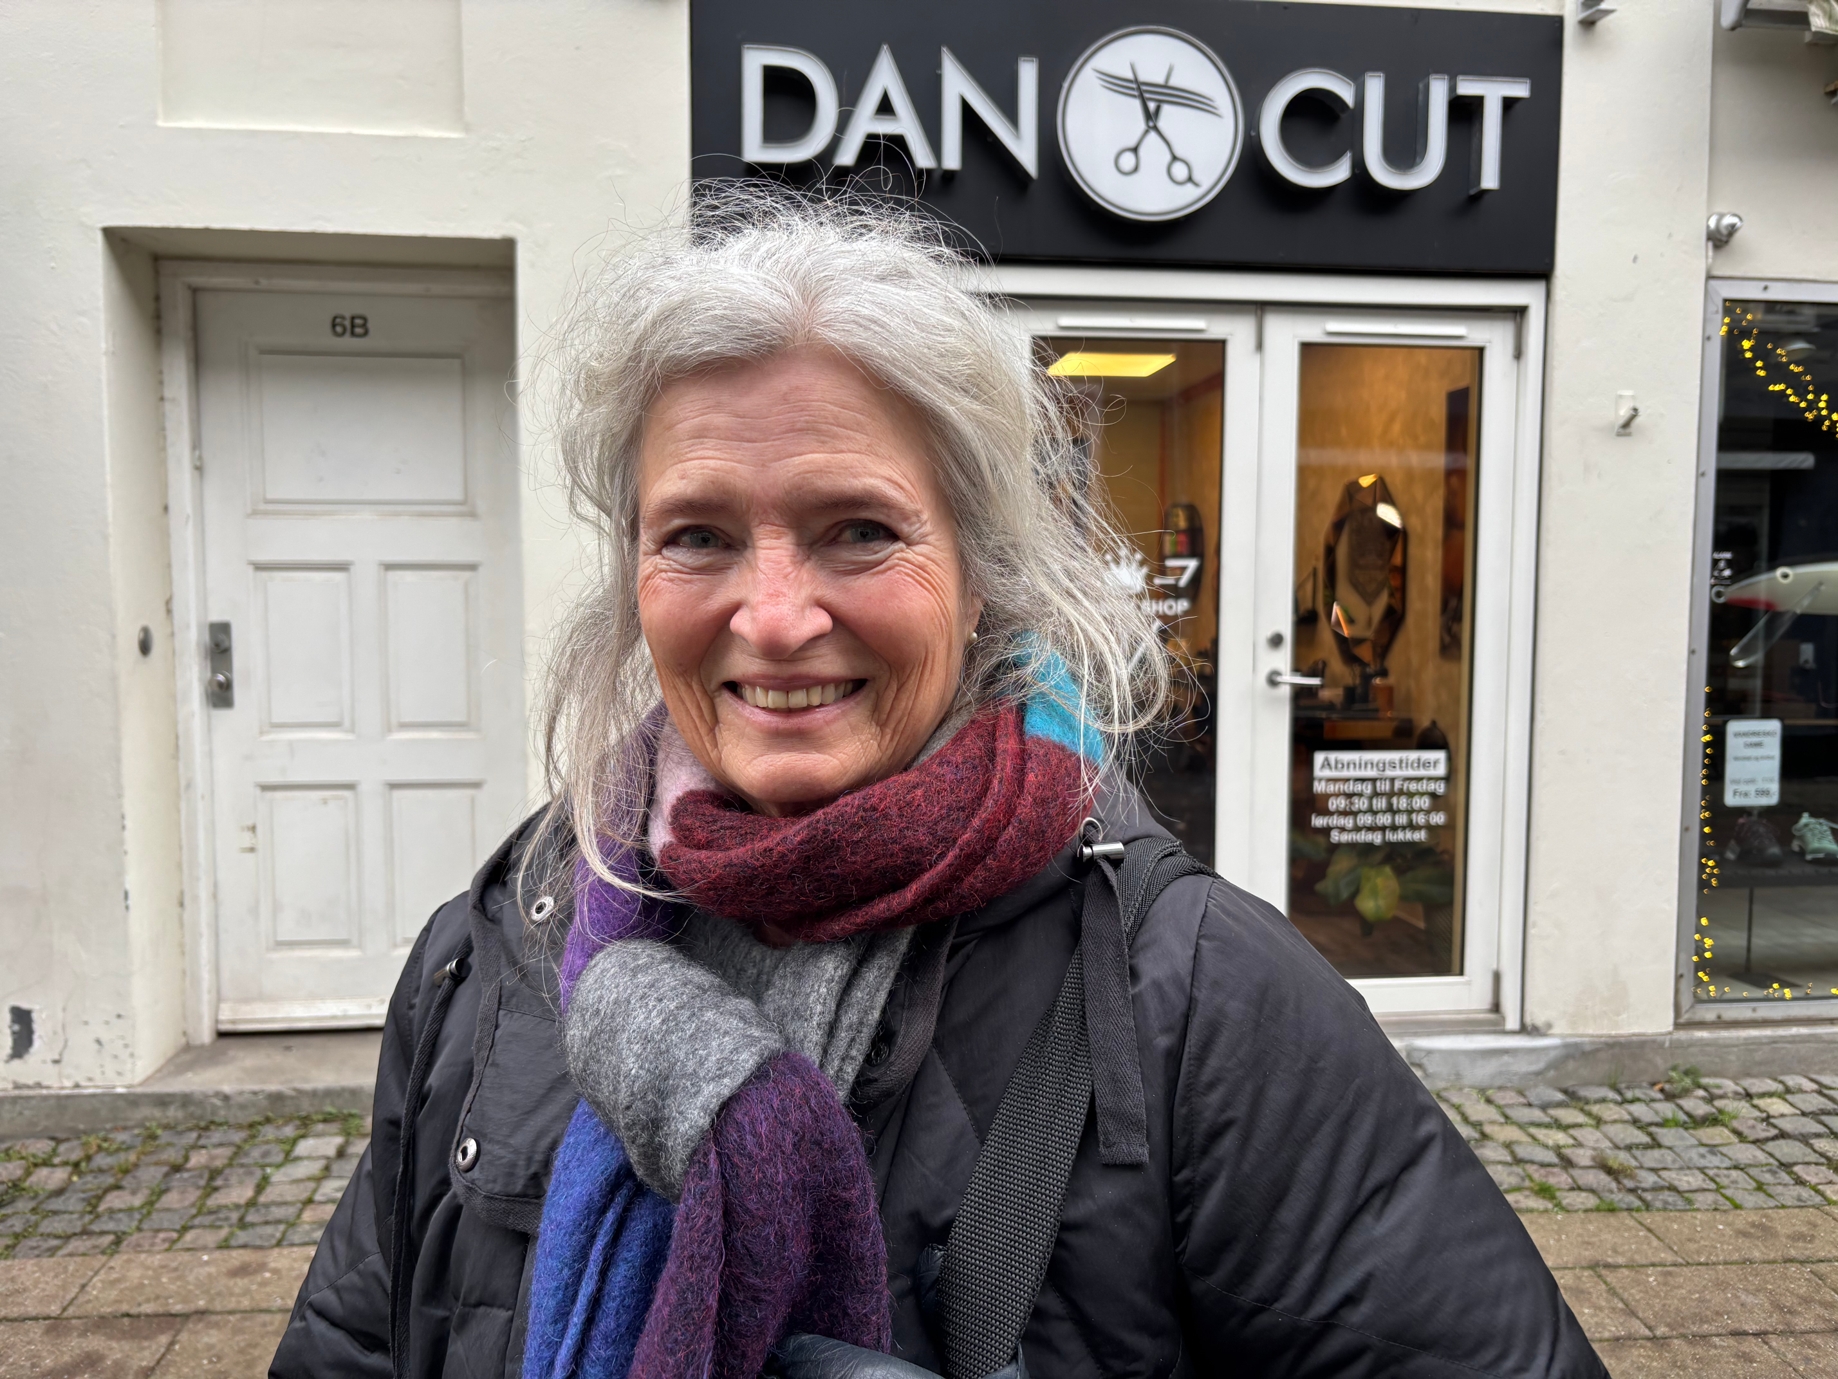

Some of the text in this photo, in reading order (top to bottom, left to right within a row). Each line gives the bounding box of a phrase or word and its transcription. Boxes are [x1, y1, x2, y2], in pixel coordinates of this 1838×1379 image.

[740, 43, 1532, 192] DAN CUT
[331, 313, 370, 338] 6B
[1319, 753, 1441, 775] Åbningstider
[1313, 777, 1446, 795] Mandag til Fredag
[1328, 796, 1368, 811] 09:30
[1372, 796, 1387, 811] til
[1394, 812, 1407, 826] til
[1330, 828, 1428, 845] Søndag lukket
